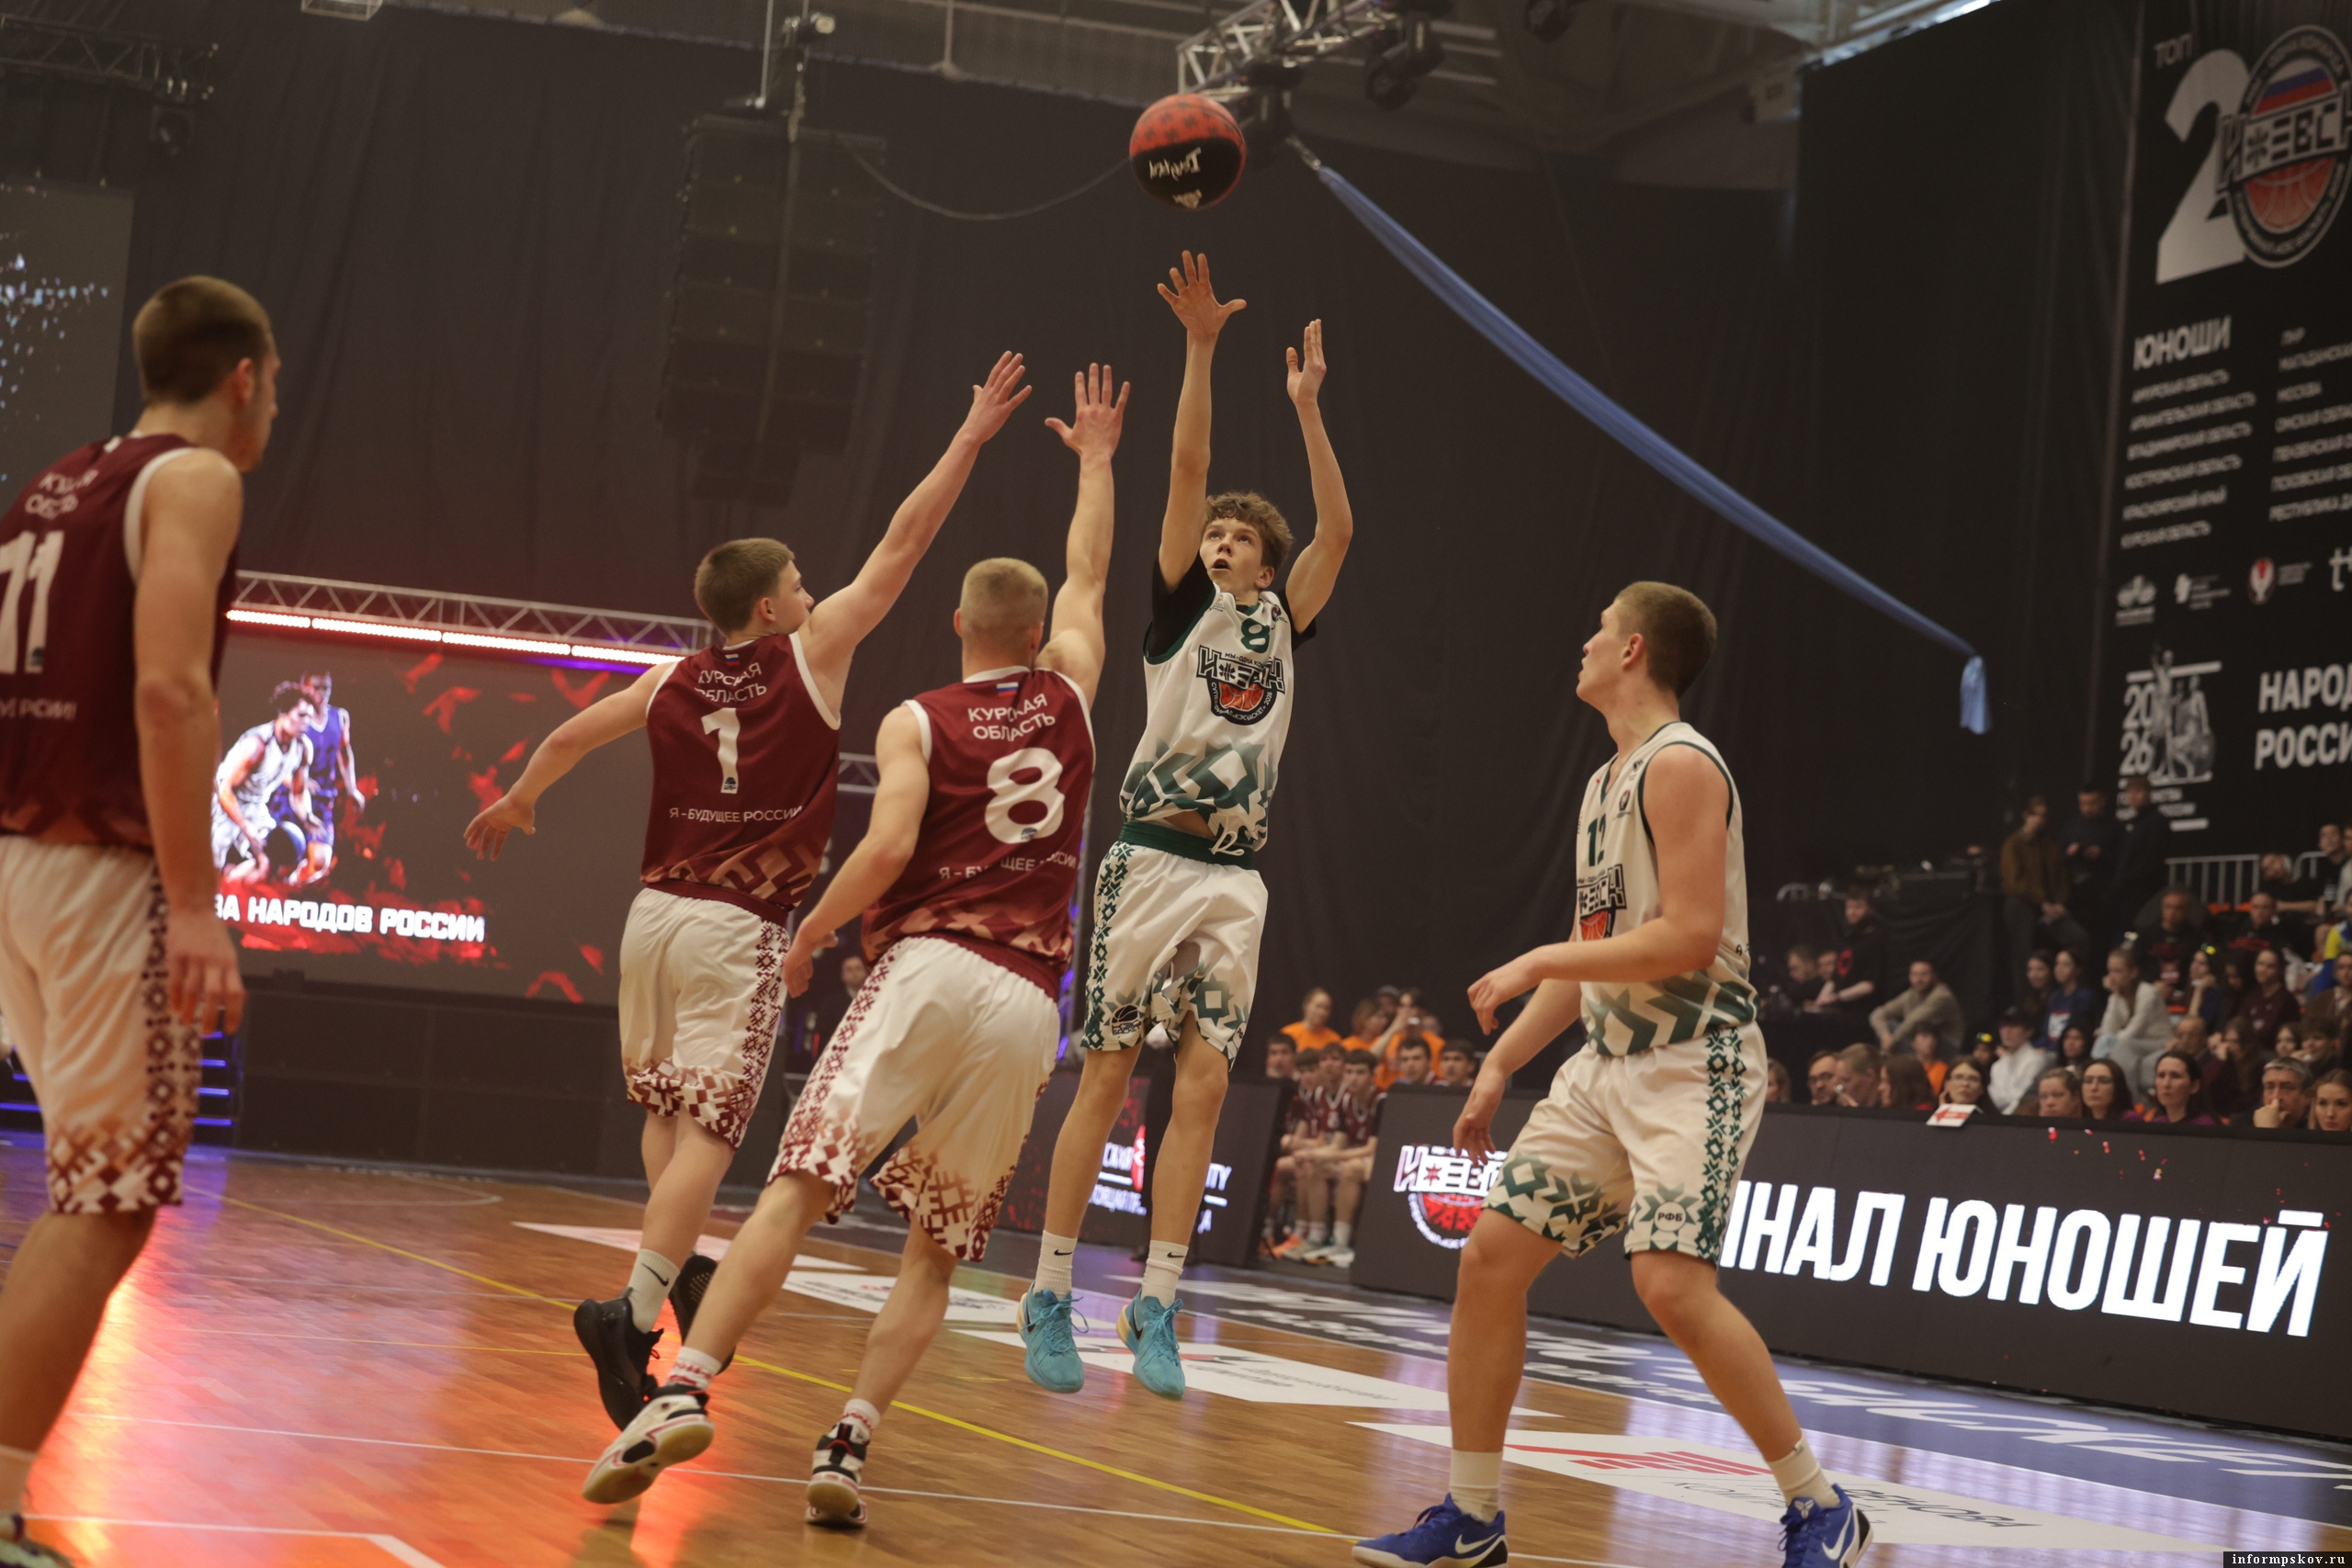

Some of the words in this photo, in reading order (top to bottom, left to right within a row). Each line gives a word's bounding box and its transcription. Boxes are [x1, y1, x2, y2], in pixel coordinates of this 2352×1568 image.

[2132, 315, 2231, 371] ЮНОШИ
[1240, 617, 1270, 653] 8
[701, 707, 741, 794] 1
[973, 713, 1057, 742] ОБЛАСТЬ
[2120, 731, 2154, 775] 26
[669, 807, 679, 818] Я
[688, 808, 741, 823] БУДУЩЕЕ
[744, 805, 803, 823] РОССИИ
[985, 747, 1066, 844] 8
[1587, 813, 1607, 867] 12
[247, 896, 373, 934] НАРОДОВ
[379, 908, 486, 943] РОССИИ
[1657, 1212, 1683, 1222] РФБ
[1912, 1196, 2329, 1338] ЮНОШЕЙ
